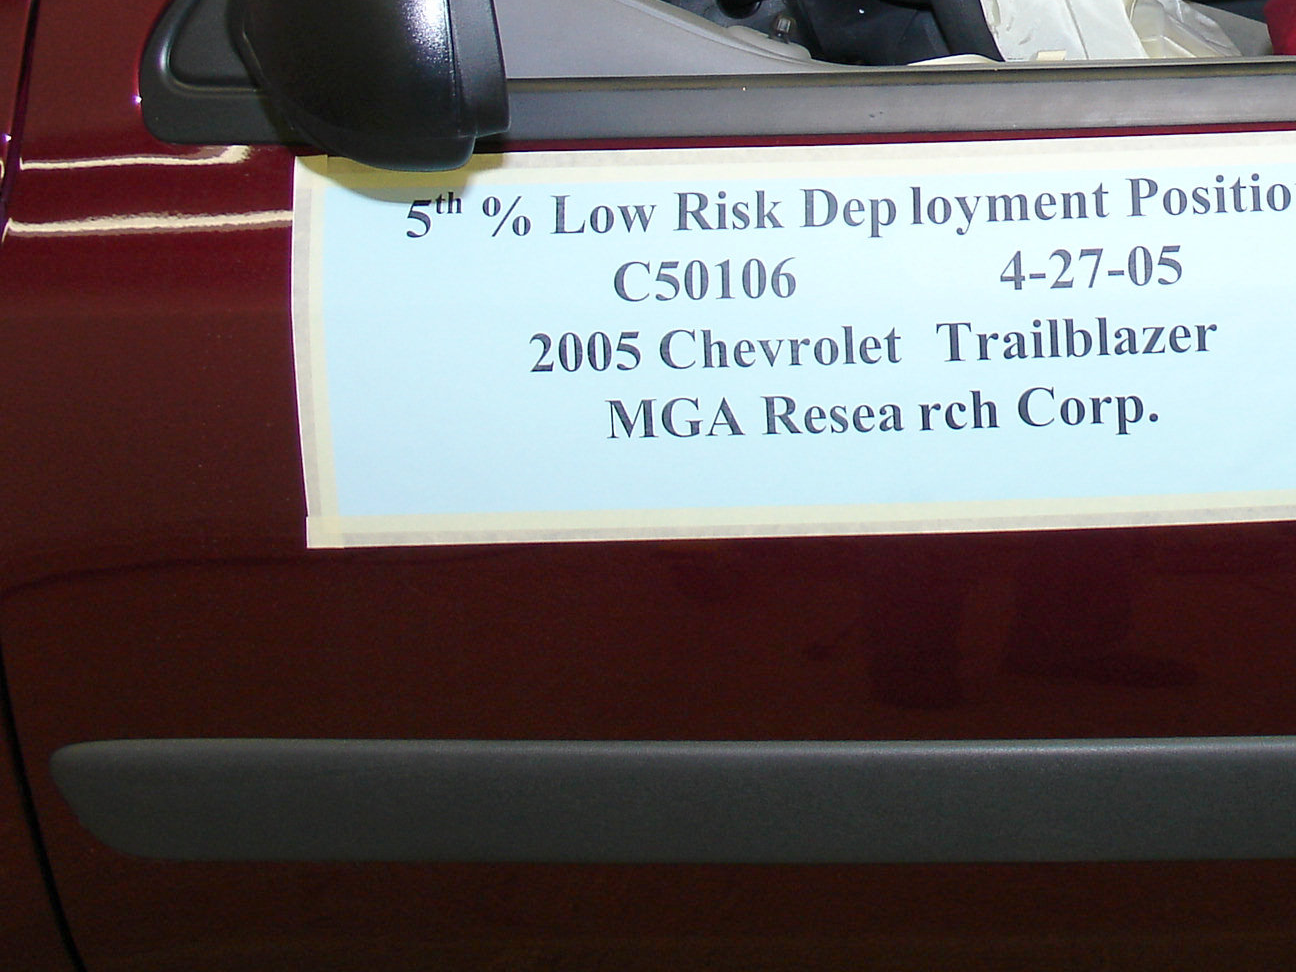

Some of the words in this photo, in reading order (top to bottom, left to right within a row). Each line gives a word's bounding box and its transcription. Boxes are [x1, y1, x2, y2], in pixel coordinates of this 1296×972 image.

[481, 195, 531, 237] %
[552, 195, 657, 235] Low
[676, 190, 783, 231] Risk
[613, 257, 797, 302] C50106
[1000, 245, 1183, 290] 4-27-05
[529, 331, 641, 373] 2005
[659, 325, 902, 370] Chevrolet
[936, 316, 1218, 362] Trailblazer
[606, 396, 746, 439] MGA
[1018, 387, 1160, 436] Corp.
